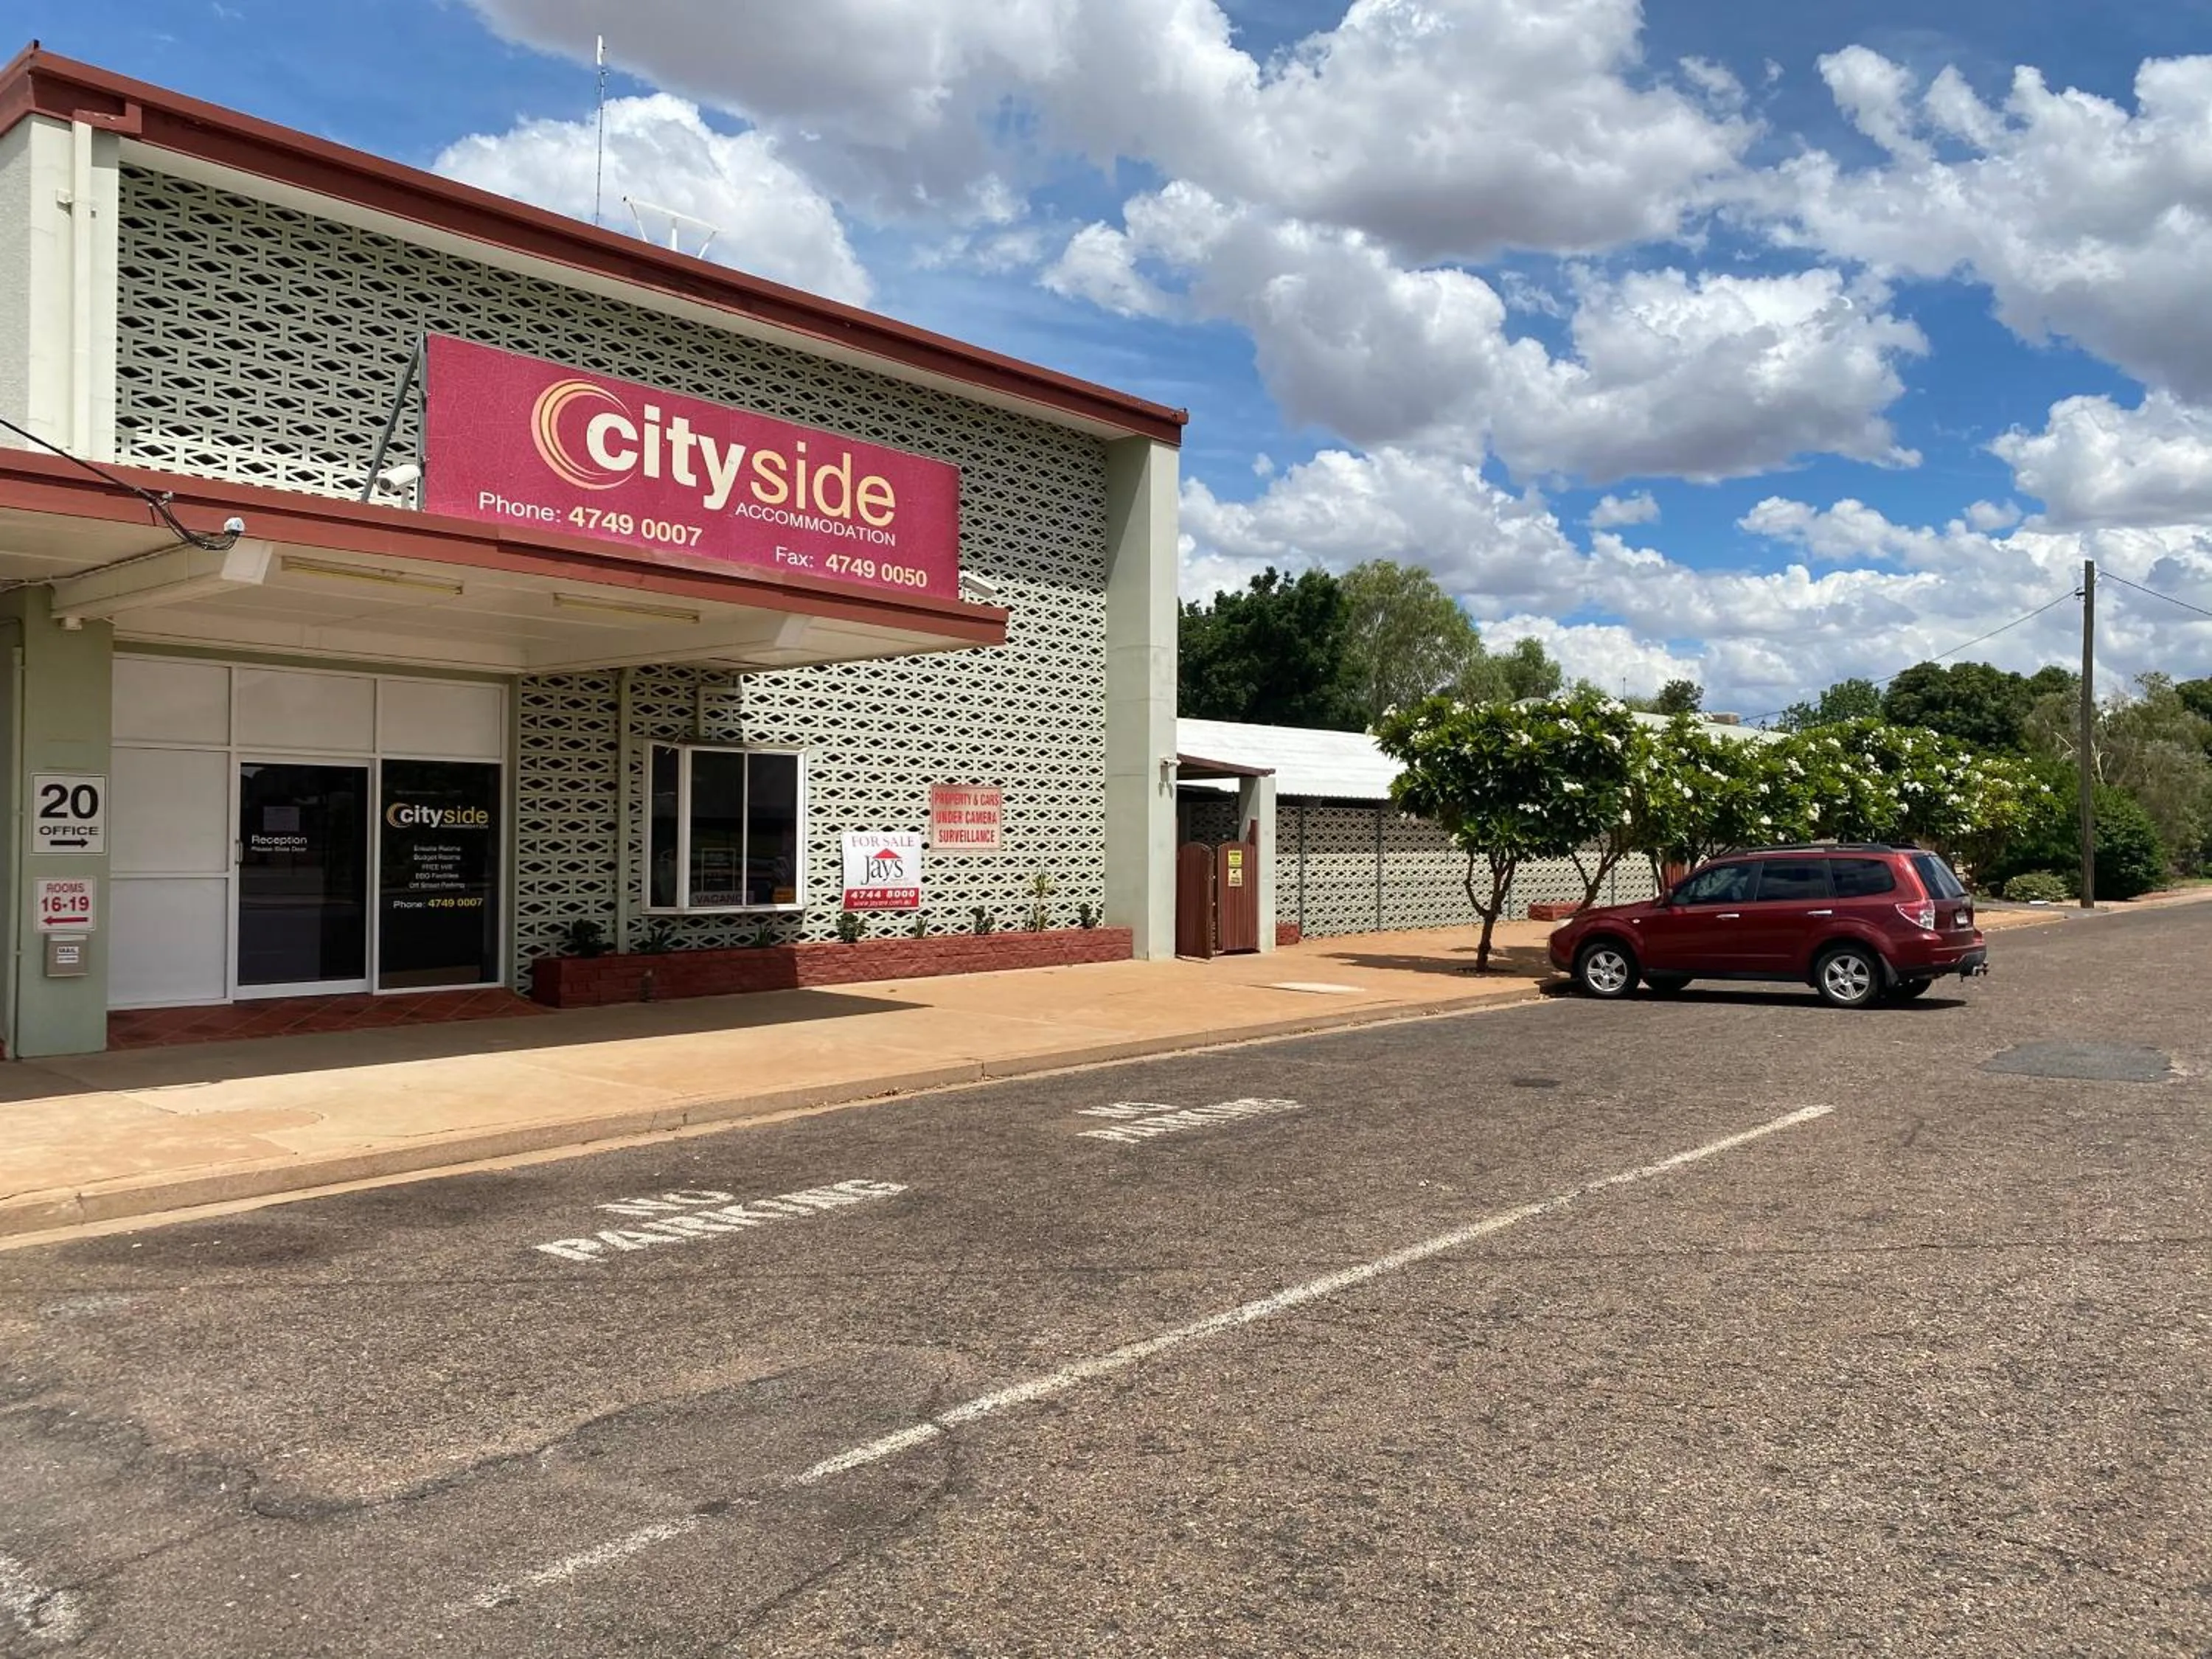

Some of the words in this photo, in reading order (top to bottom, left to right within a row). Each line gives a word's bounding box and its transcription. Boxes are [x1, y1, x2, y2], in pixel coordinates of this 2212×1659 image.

[587, 403, 896, 526] cityside
[479, 492, 561, 523] Phone:
[568, 507, 633, 535] 4749
[641, 518, 702, 546] 0007
[735, 502, 896, 546] ACCOMMODATION
[776, 546, 814, 568] Fax:
[826, 554, 875, 578] 4749
[881, 563, 927, 588] 0050
[40, 784, 99, 819] 20
[935, 793, 971, 805] PROPERTY
[974, 794, 978, 805] &
[981, 794, 998, 806] CARS
[400, 805, 488, 827] cityside
[936, 810, 962, 824] UNDER
[966, 811, 997, 824] CAMERA
[40, 826, 100, 835] OFFICE
[939, 830, 995, 842] SURVEILLANCE
[251, 834, 307, 846] Reception
[852, 836, 879, 847] FOR
[883, 836, 914, 847] SALE
[860, 855, 903, 885] Jays
[46, 883, 85, 893] ROOMS
[850, 891, 881, 899] 4744
[886, 890, 915, 898] 8000
[428, 899, 455, 908] 4749
[457, 897, 483, 906] 0007
[696, 894, 754, 904] VACANC
[594, 1189, 735, 1217] NO
[532, 1180, 909, 1262] PARKING
